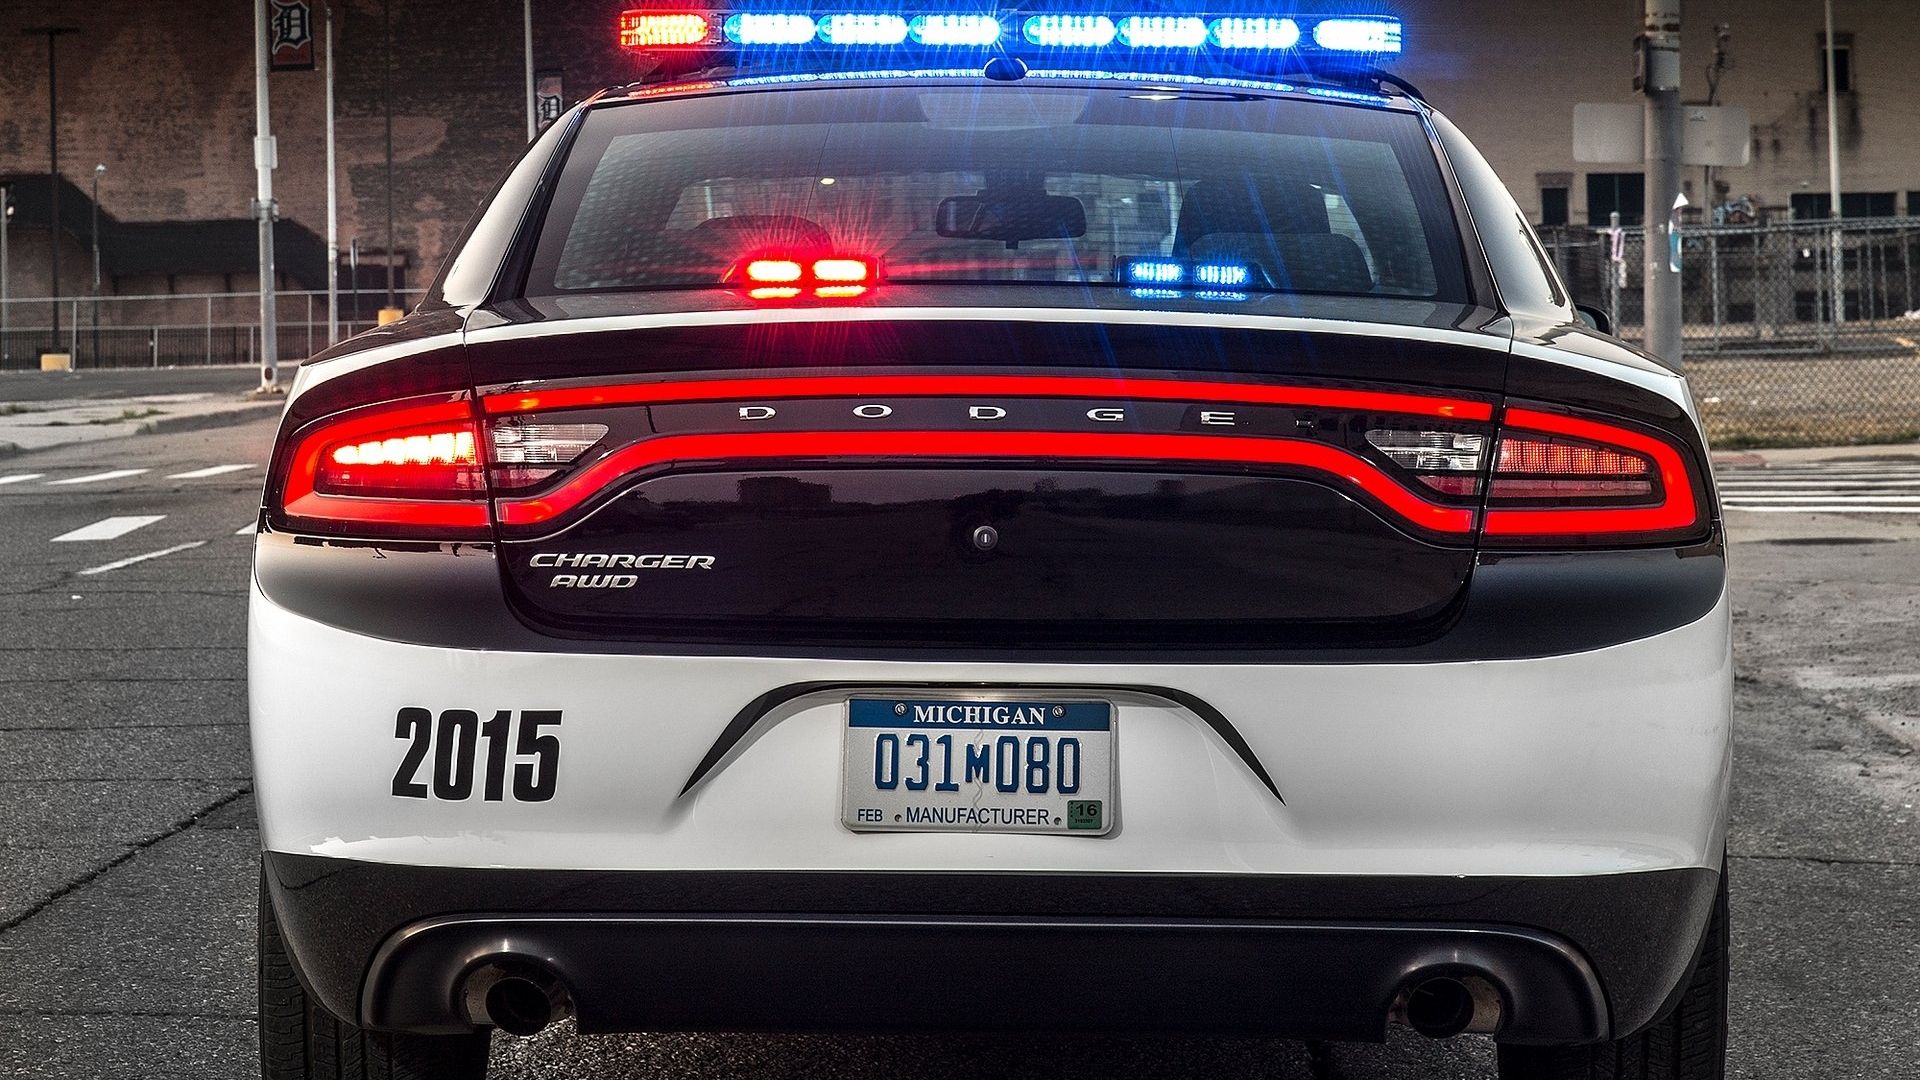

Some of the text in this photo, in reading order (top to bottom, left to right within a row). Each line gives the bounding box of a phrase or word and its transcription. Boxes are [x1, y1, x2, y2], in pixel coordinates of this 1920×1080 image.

[738, 404, 1236, 426] DODGE
[529, 553, 716, 570] CHARGER
[549, 574, 639, 589] AWD
[913, 704, 1046, 725] MICHIGAN
[391, 706, 563, 802] 2015
[857, 806, 1050, 825] FEB MANUFACTURER
[1075, 803, 1098, 816] 16
